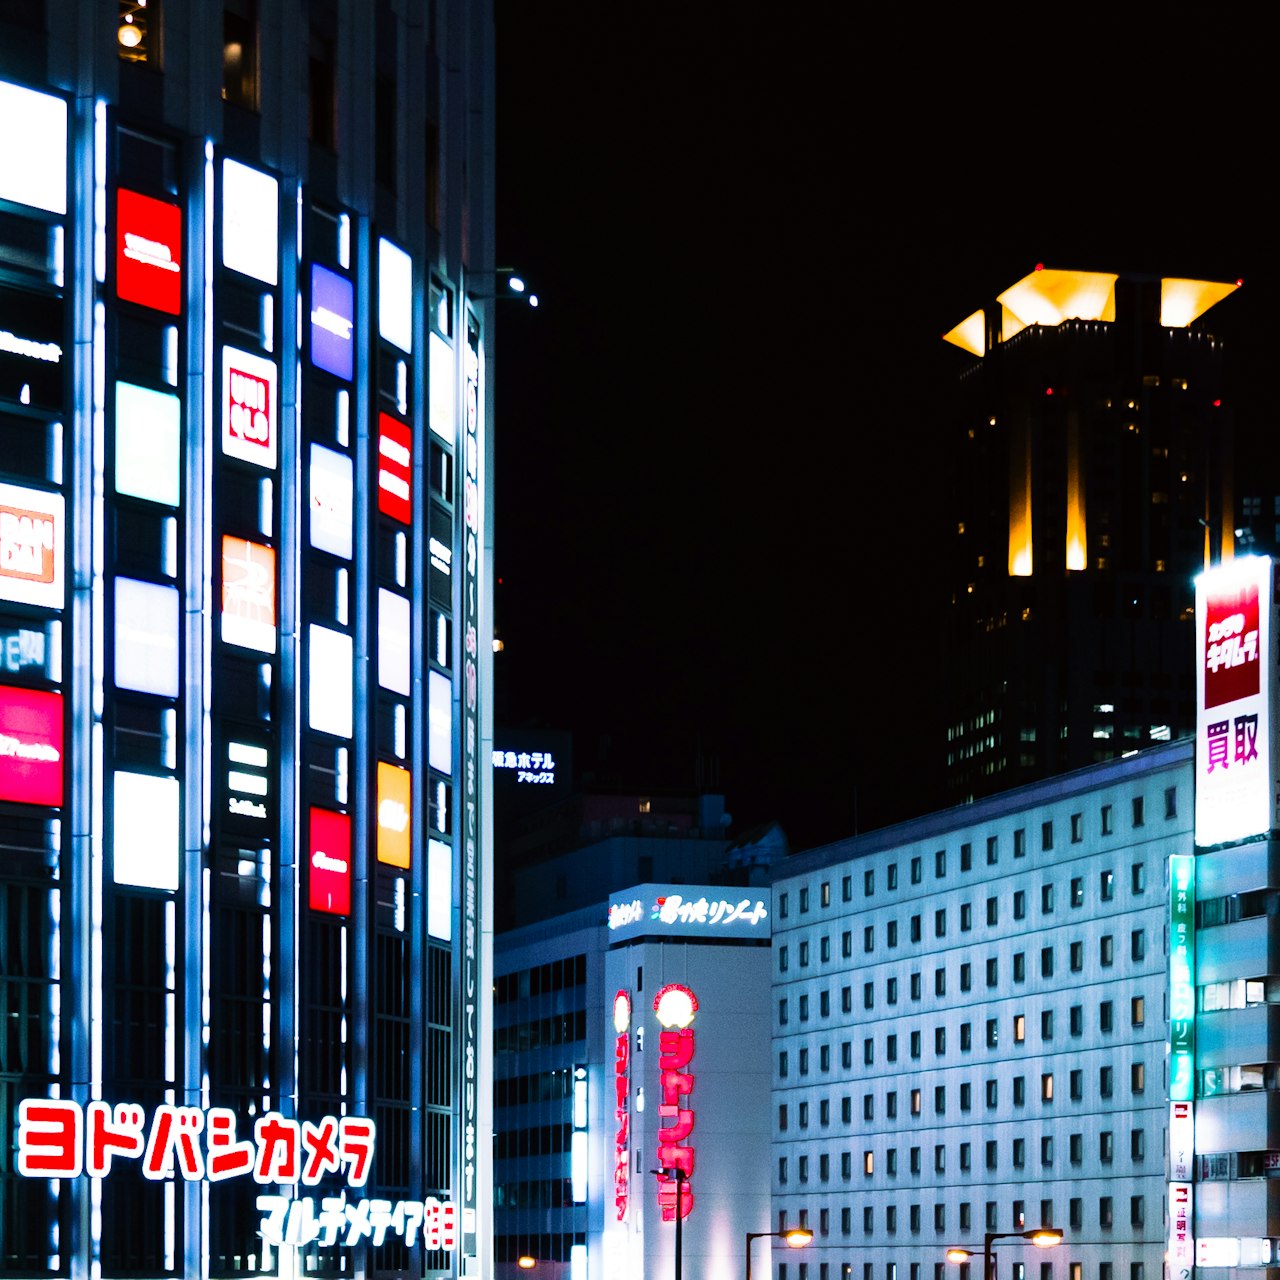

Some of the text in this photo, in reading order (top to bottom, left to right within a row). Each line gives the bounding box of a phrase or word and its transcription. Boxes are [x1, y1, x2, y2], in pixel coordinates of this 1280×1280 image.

[230, 370, 266, 402] UNI
[1207, 630, 1259, 674] キタムラ
[1207, 712, 1259, 776] 買取
[518, 771, 555, 784] アネックス
[18, 1098, 377, 1187] ヨドバシカメラ
